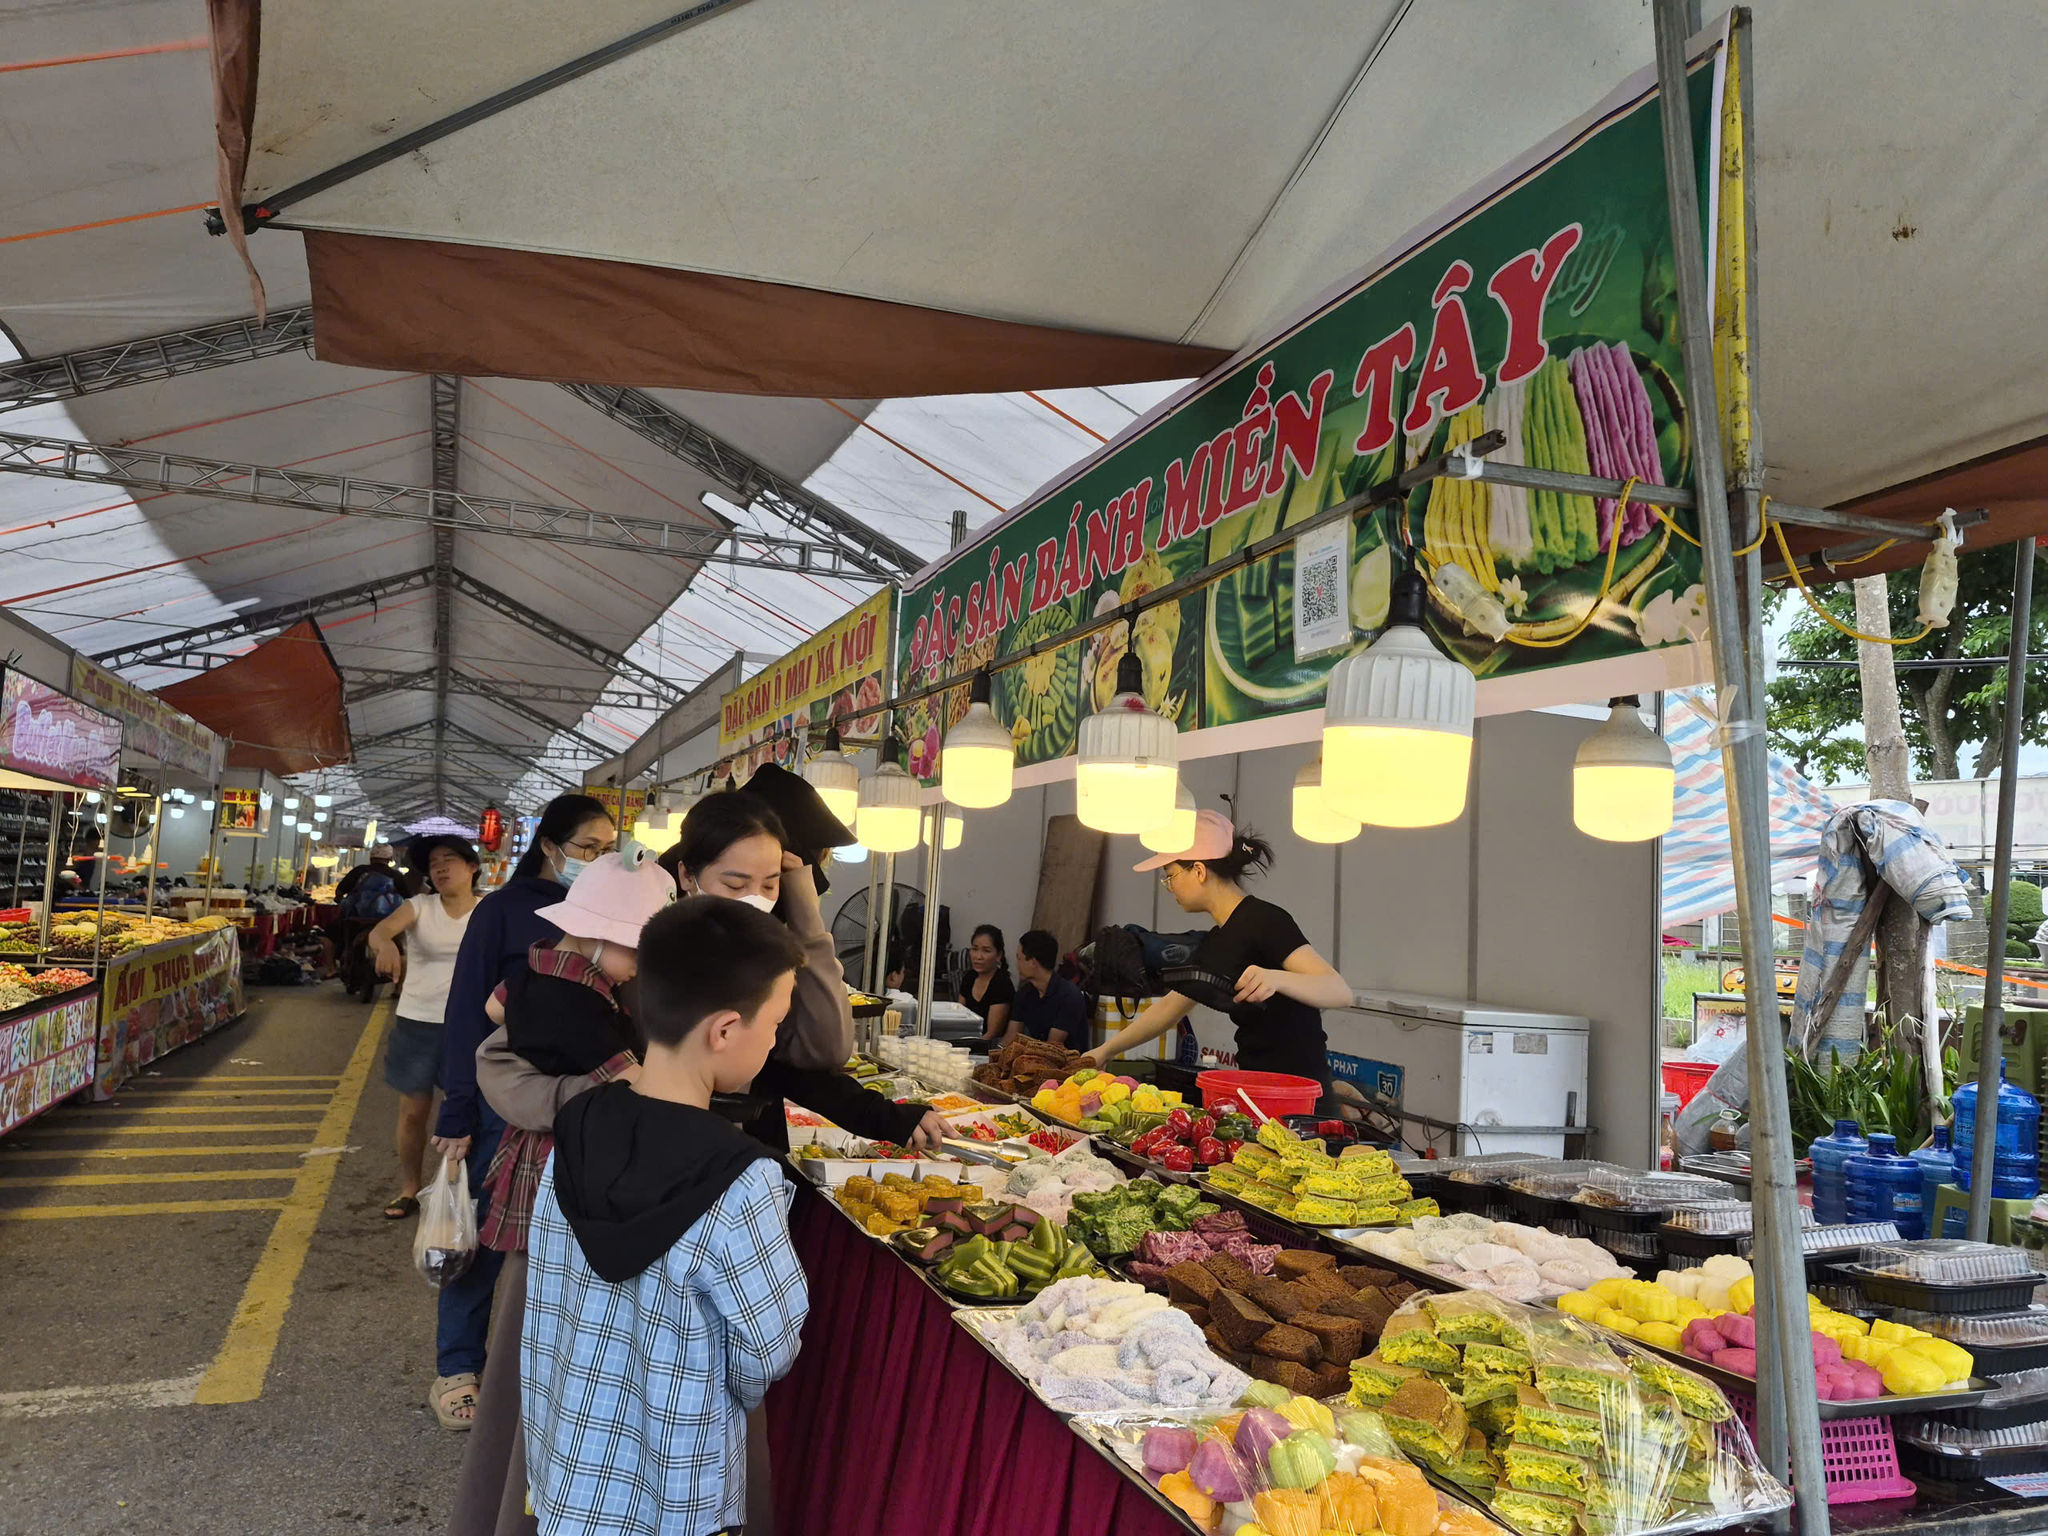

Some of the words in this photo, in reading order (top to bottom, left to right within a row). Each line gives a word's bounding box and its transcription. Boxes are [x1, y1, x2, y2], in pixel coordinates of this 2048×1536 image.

[910, 586, 961, 681] ĐẶC
[964, 546, 1028, 646] SẢN
[1029, 477, 1152, 616] BÁNH
[1156, 360, 1334, 551] MIỀN
[1353, 222, 1583, 456] TÂY
[747, 675, 770, 721] SẢN
[774, 667, 782, 709] Ô
[785, 654, 813, 703] MAI
[840, 612, 877, 673] NỘI
[1382, 1081, 1393, 1095] 30
